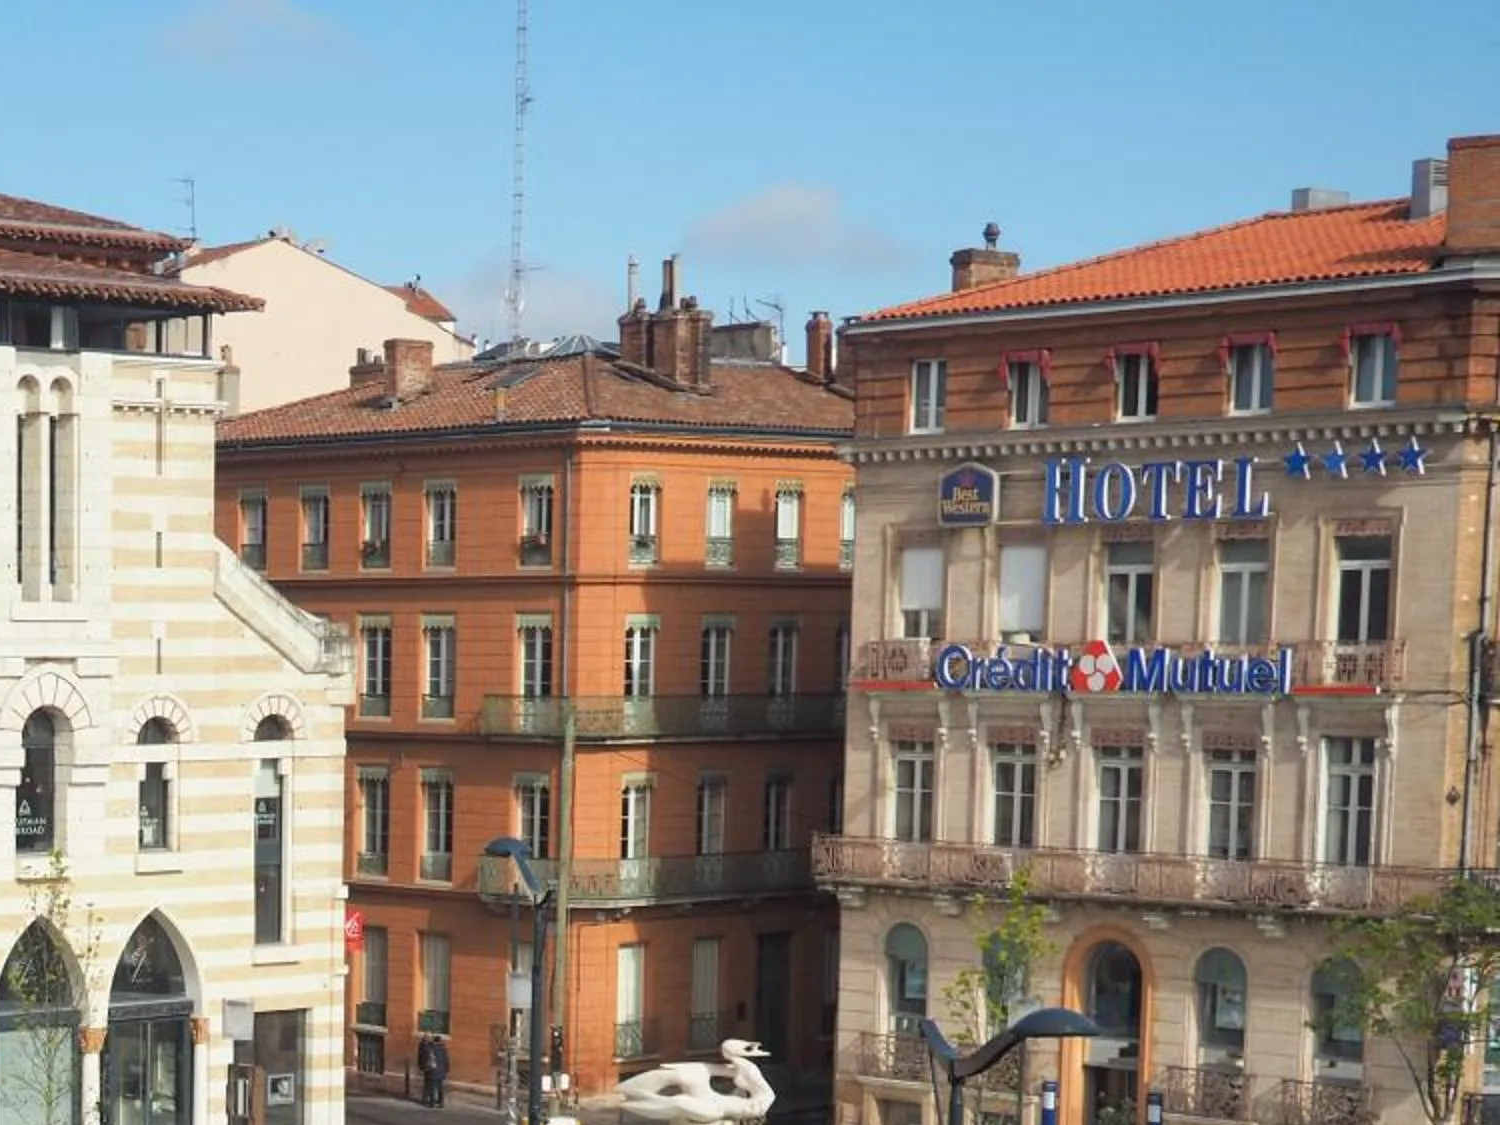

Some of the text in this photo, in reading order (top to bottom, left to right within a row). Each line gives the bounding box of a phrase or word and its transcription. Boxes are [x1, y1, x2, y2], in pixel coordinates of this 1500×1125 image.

[1043, 456, 1270, 527] HOTEL
[935, 644, 1293, 695] Crédit Mutuel
